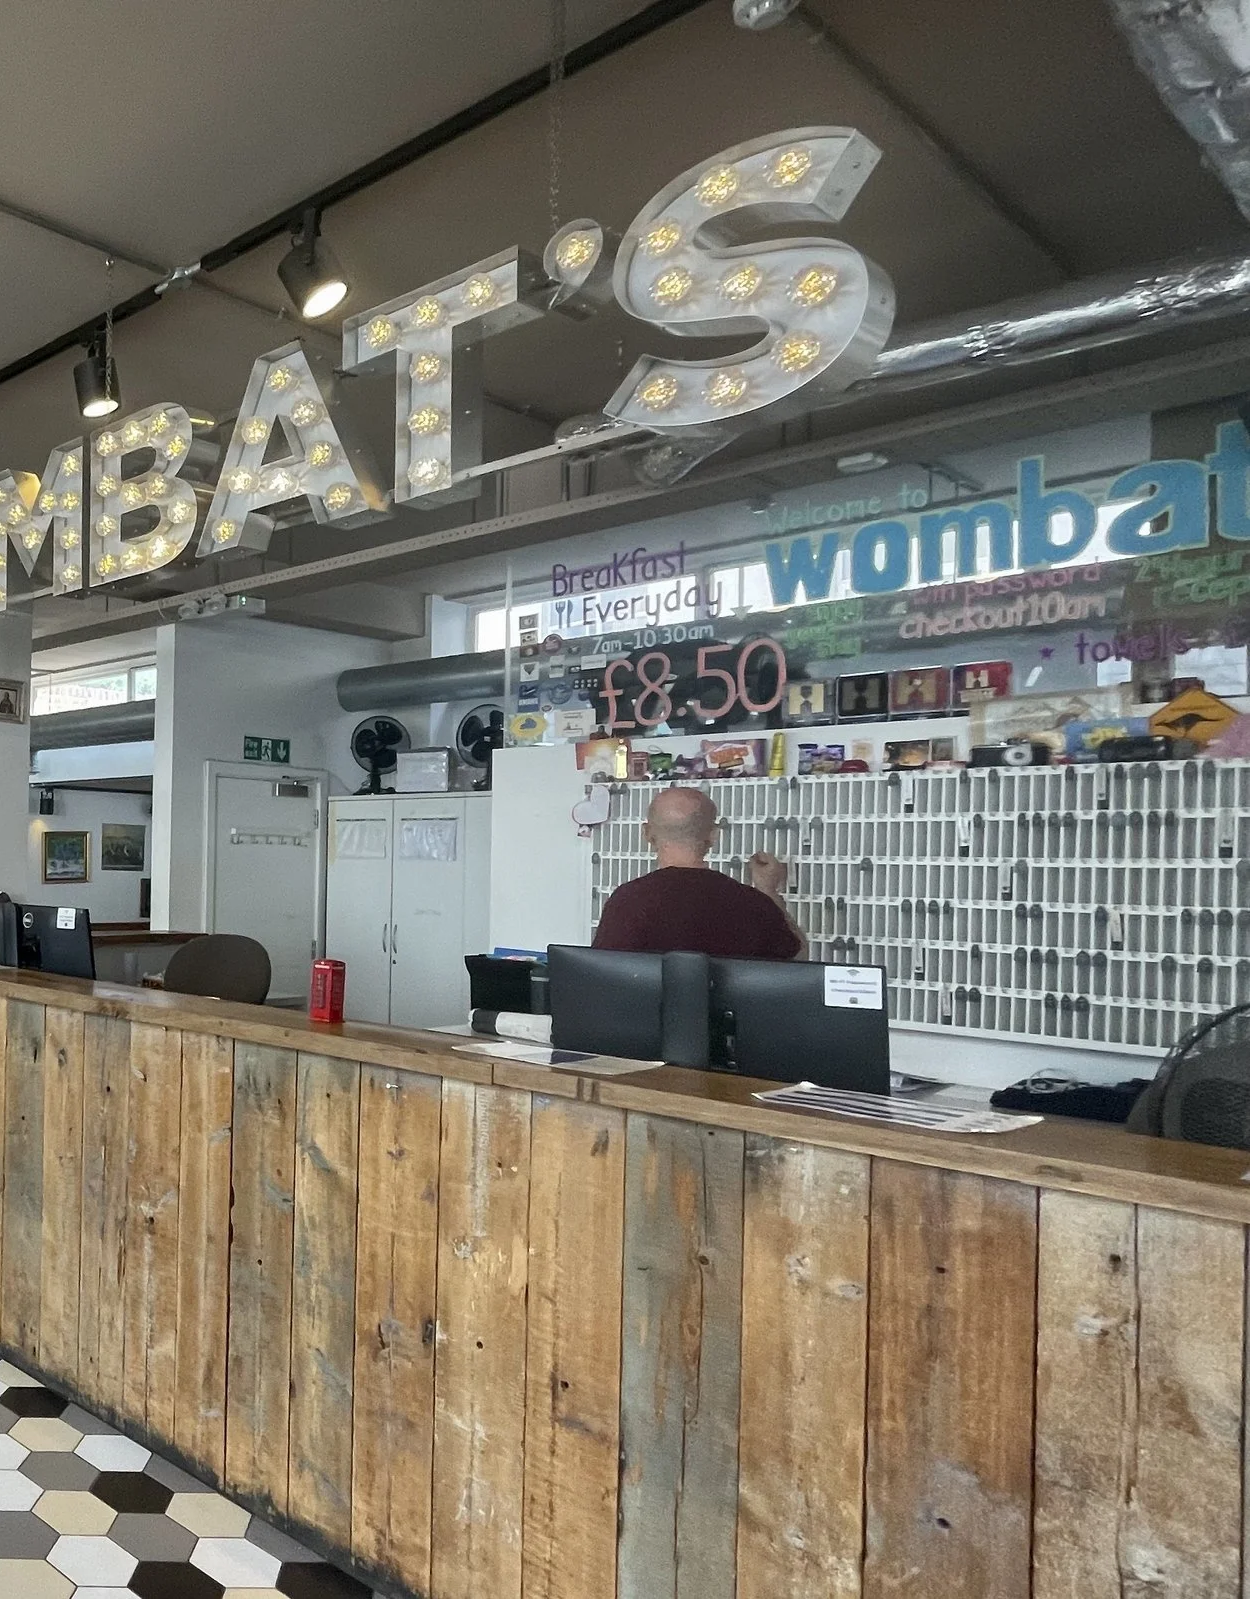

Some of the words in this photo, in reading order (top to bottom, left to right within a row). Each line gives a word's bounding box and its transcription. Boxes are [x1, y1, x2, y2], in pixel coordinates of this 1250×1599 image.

[900, 483, 928, 509] to
[582, 579, 723, 627] Everyday
[598, 637, 787, 731] £8.50
